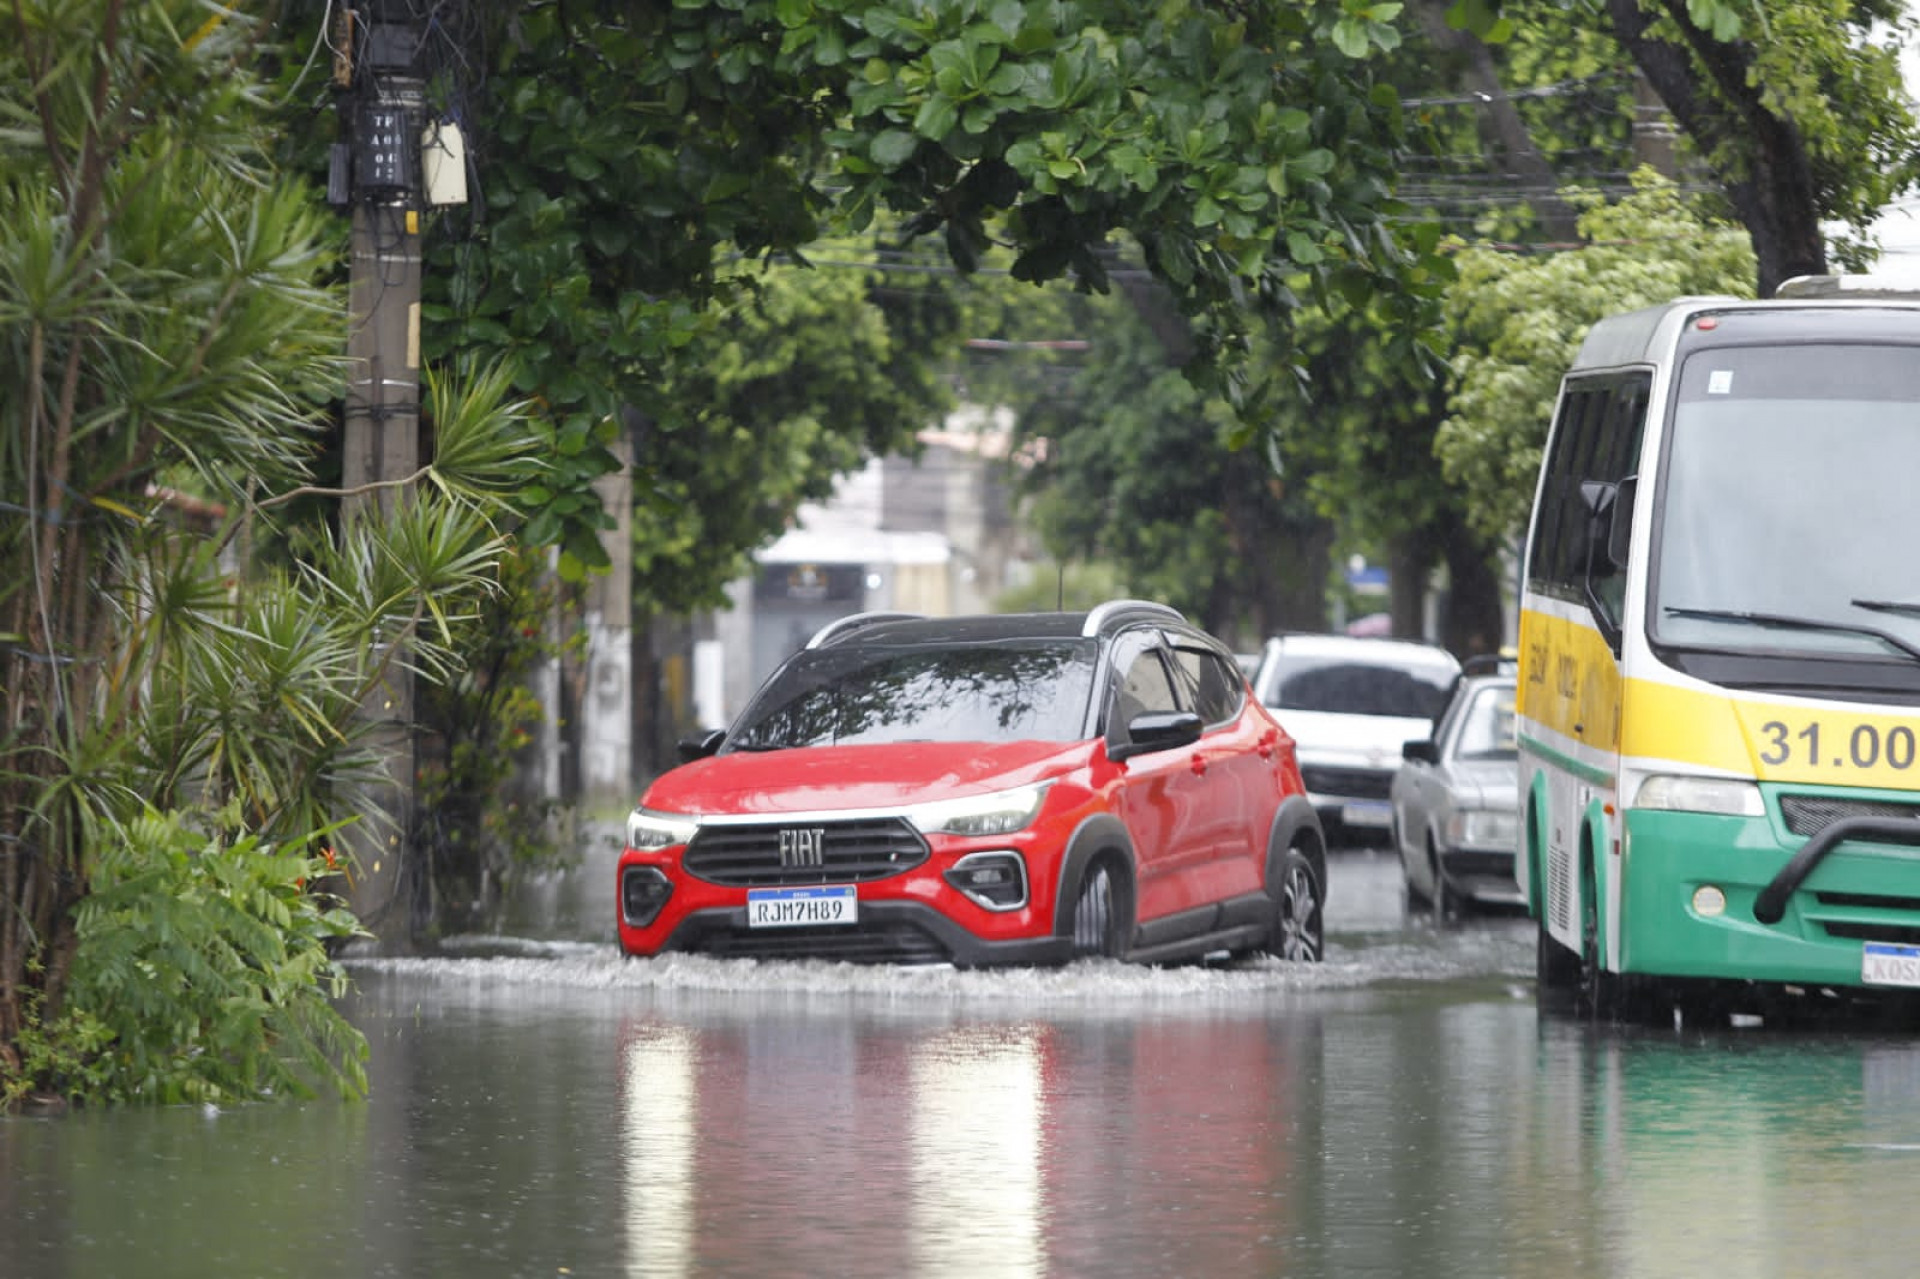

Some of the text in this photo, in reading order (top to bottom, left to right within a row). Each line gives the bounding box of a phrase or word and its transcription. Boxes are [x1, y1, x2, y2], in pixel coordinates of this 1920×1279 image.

[1760, 720, 1916, 770] 31.00
[779, 828, 825, 867] FIAT
[758, 900, 842, 922] RJM7H89
